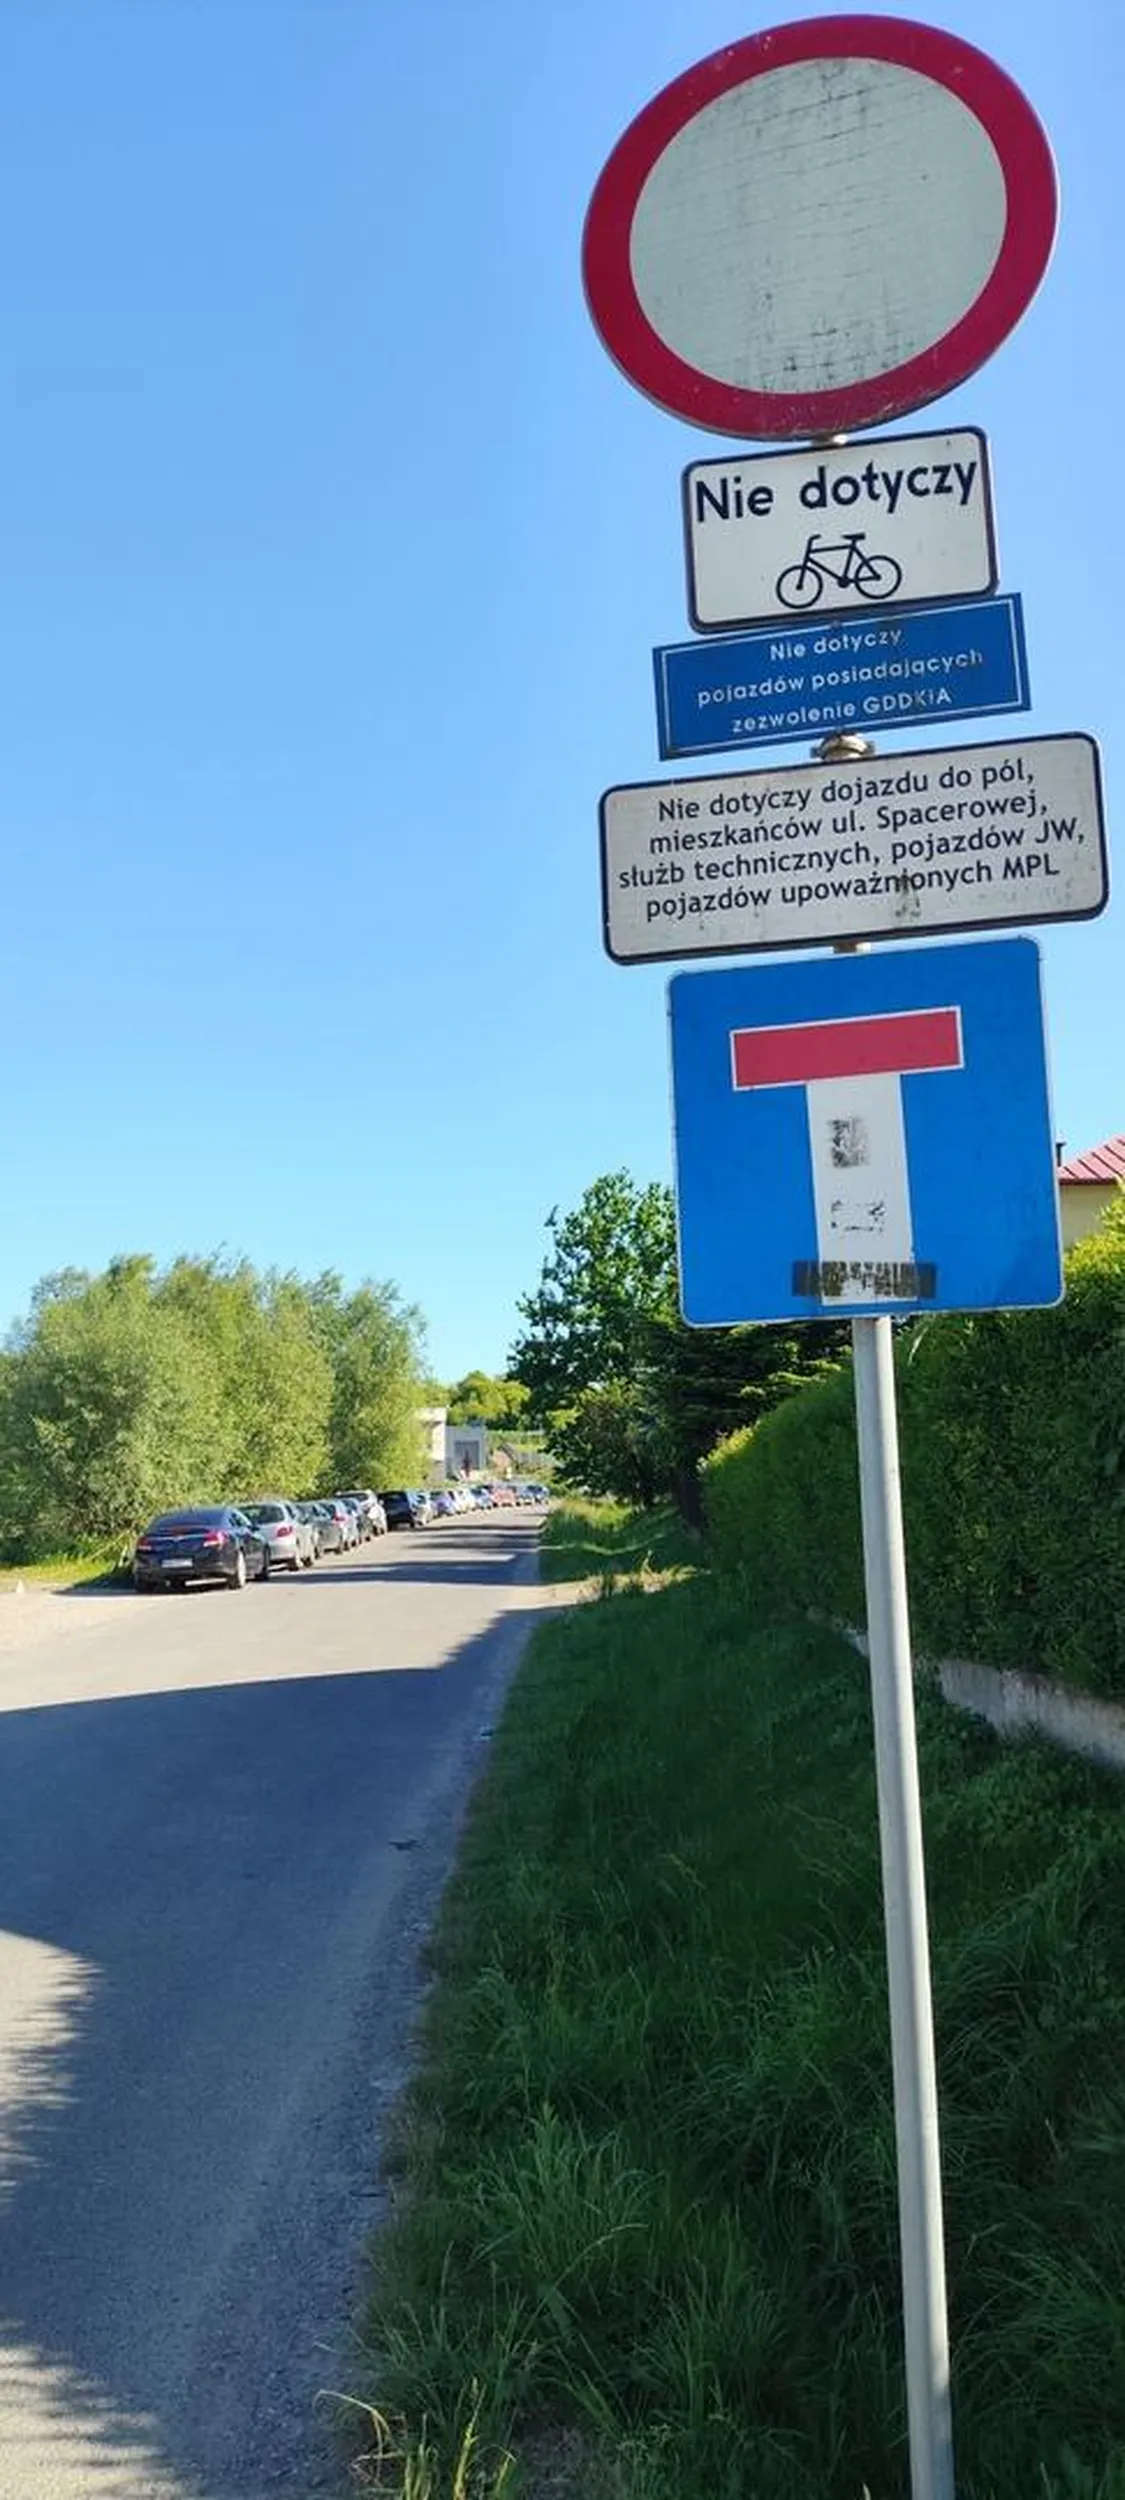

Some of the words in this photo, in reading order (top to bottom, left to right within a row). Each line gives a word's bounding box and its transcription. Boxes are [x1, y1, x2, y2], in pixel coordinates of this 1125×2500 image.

[695, 475, 774, 522] Nie
[799, 461, 977, 513] dotyczy
[770, 643, 806, 661] Nie
[813, 628, 903, 653] dotyczy
[698, 675, 805, 708] pojazdów
[811, 649, 983, 691] posiadających
[732, 701, 856, 734] zezwolenie
[862, 687, 952, 715] GDDKiA
[658, 798, 700, 822] Nie
[709, 788, 811, 817] dotyczy
[821, 771, 928, 805] dojazdu
[939, 766, 972, 788] do
[982, 758, 1034, 790] pól,
[650, 817, 822, 854] mieszkańców
[832, 810, 865, 834] ul.
[876, 789, 1048, 833] Spacerowej,
[619, 861, 685, 889] służb
[694, 841, 881, 882] technicznych,
[891, 825, 1024, 864] pojazdów
[1034, 817, 1085, 845] JW,
[646, 885, 771, 922] pojazdów
[781, 860, 992, 909] upoważnionych
[1002, 853, 1060, 880] MPL
